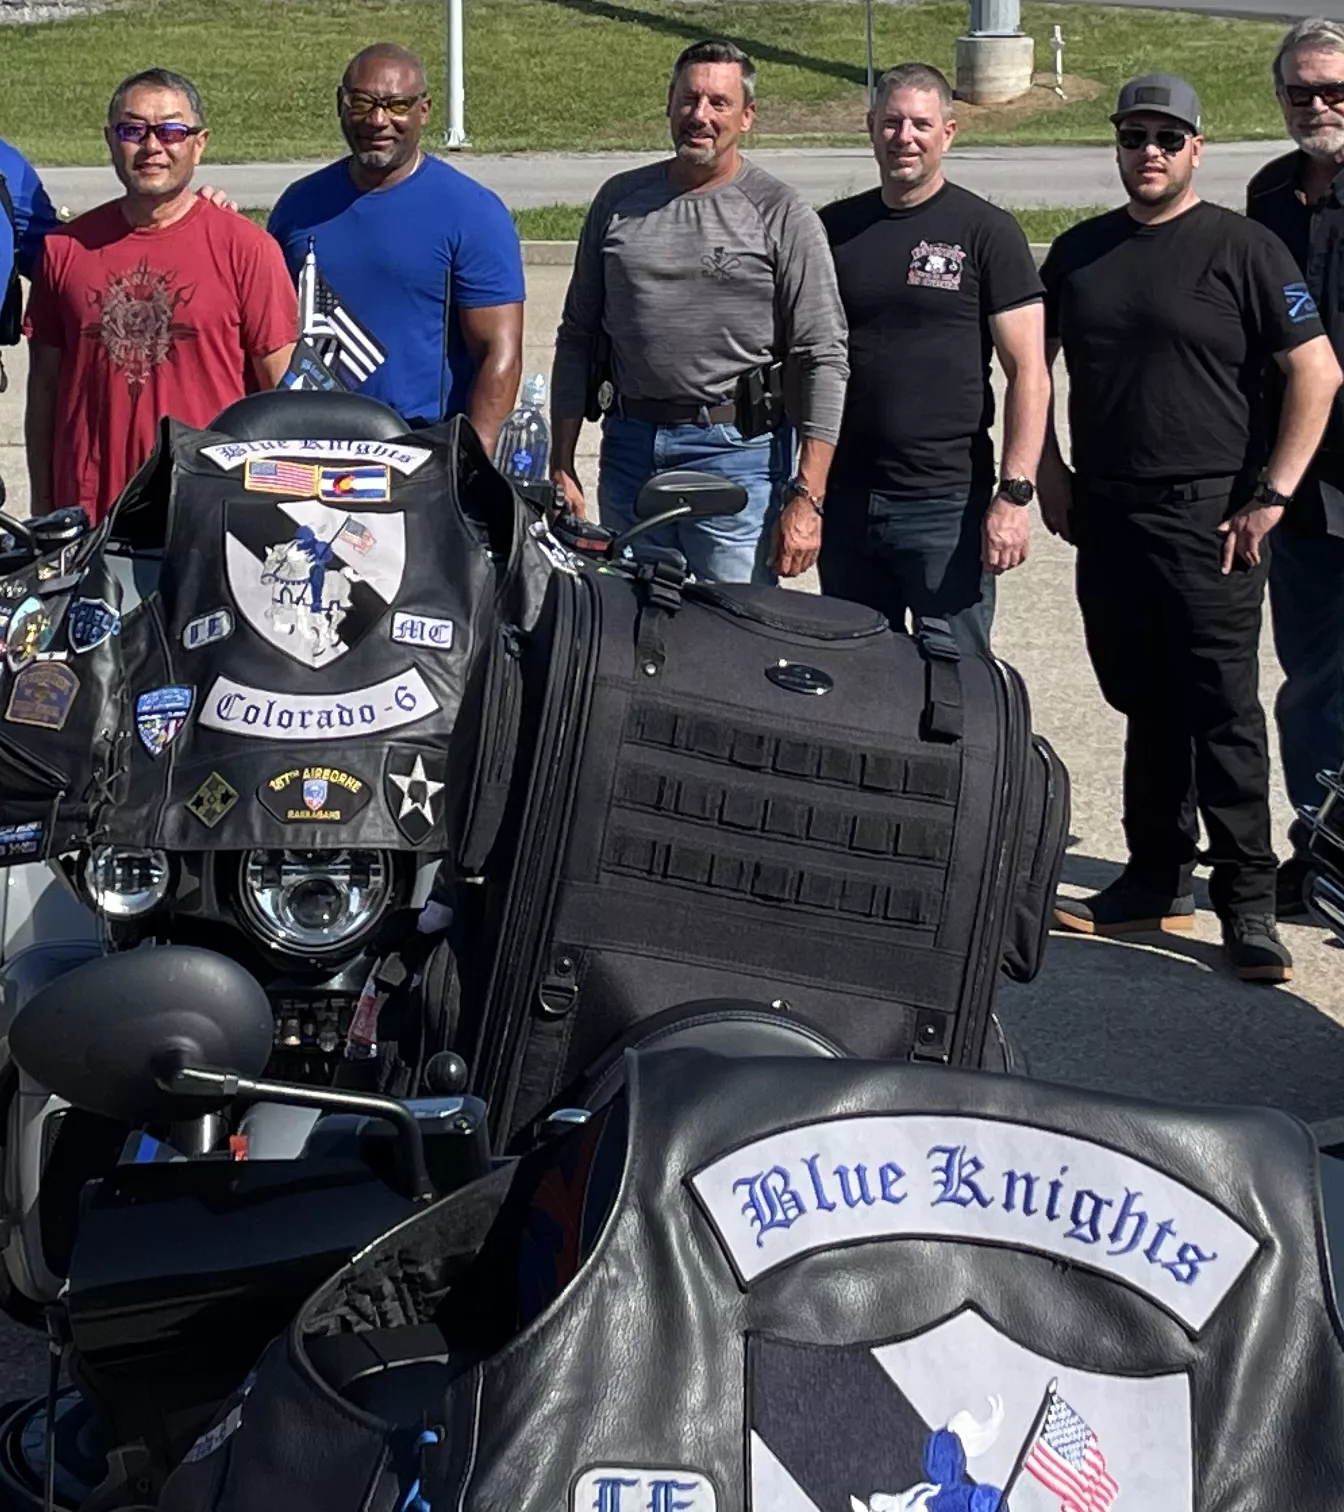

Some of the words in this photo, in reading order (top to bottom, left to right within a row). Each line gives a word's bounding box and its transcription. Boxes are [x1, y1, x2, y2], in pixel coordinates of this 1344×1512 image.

[215, 440, 290, 462] Blue
[297, 439, 417, 464] Knights
[395, 618, 450, 644] MC
[216, 692, 376, 730] Colorado
[302, 767, 363, 793] AIRBORNE
[732, 1153, 908, 1248] Blue
[926, 1144, 1218, 1286] Knights
